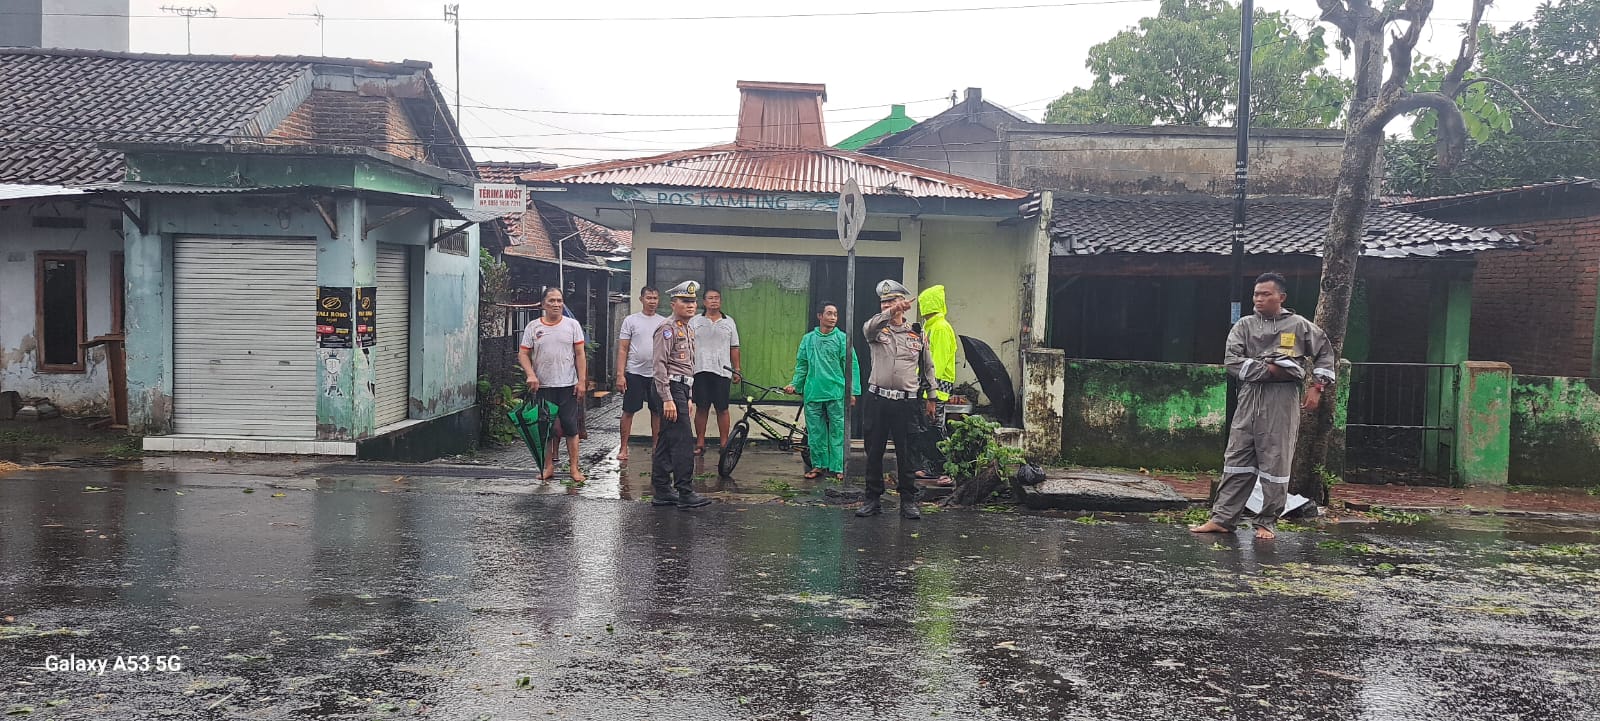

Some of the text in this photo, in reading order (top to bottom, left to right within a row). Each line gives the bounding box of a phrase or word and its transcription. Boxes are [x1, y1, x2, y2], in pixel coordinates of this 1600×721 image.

[479, 189, 522, 199] TERIMA KOST
[657, 192, 788, 210] POS KAMLING
